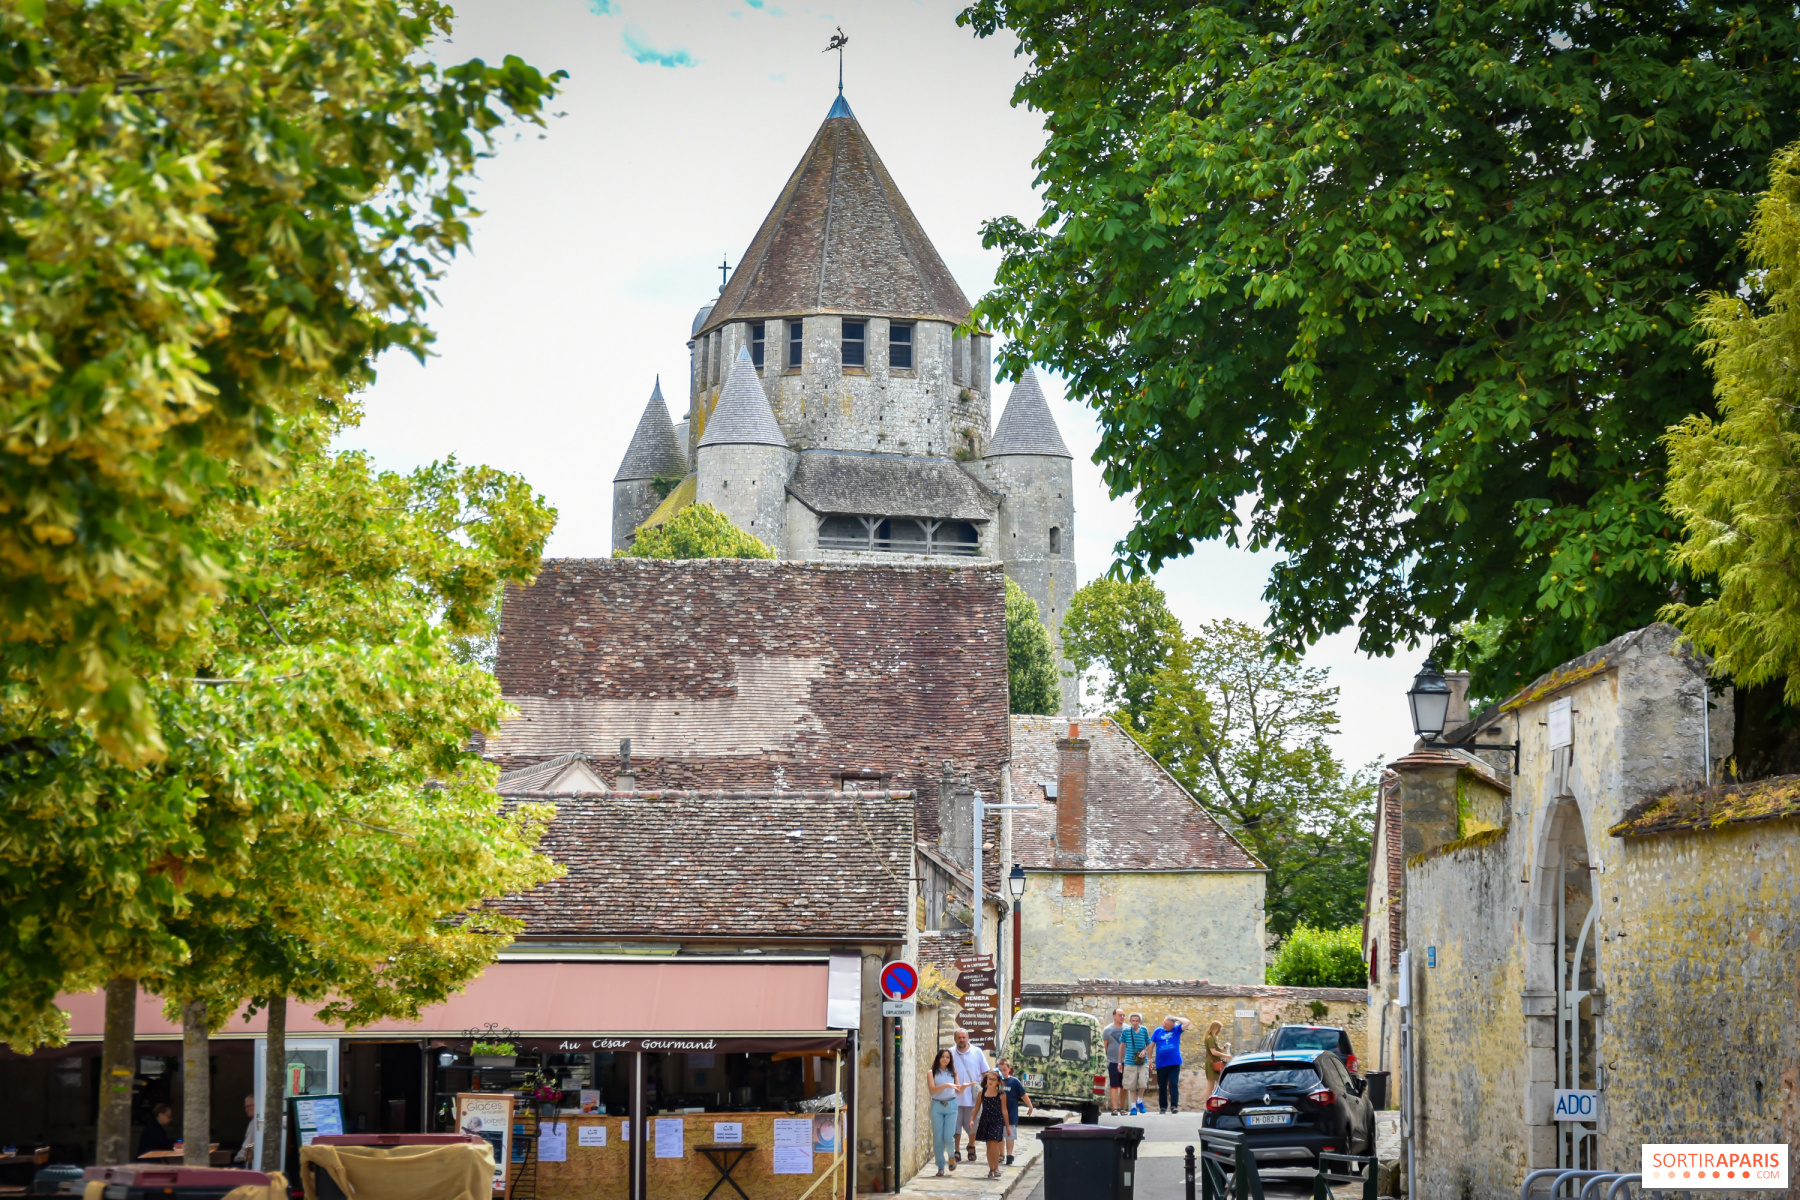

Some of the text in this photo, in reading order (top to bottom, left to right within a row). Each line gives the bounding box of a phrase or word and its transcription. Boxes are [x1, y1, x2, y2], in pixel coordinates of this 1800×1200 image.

[559, 1039, 717, 1050] Au César Gourmand
[466, 1102, 503, 1112] Glaces
[1251, 1114, 1286, 1124] FM 082 FV
